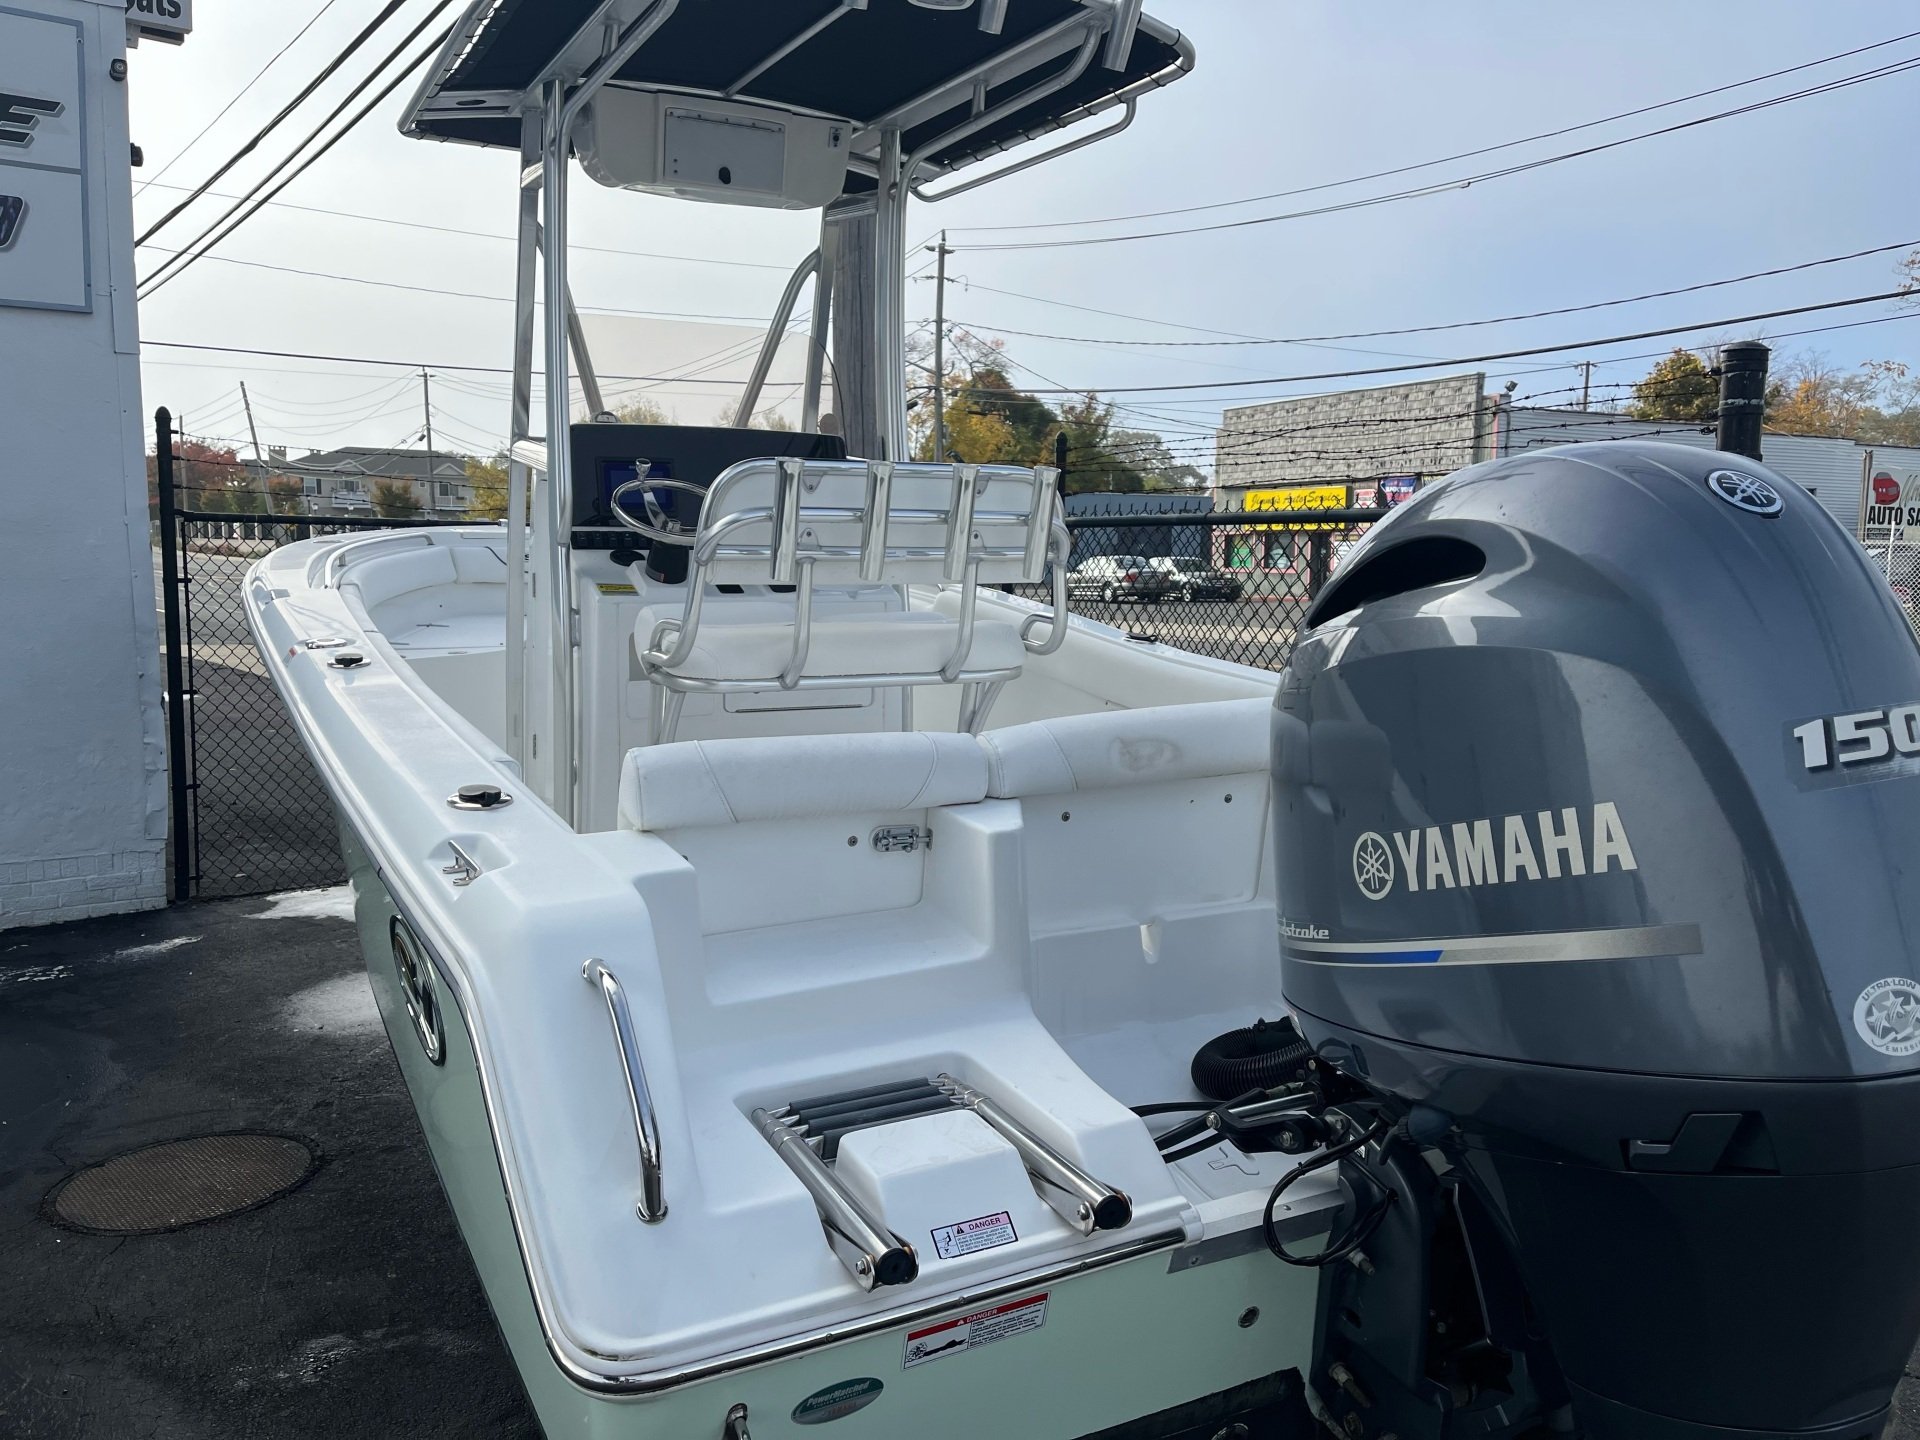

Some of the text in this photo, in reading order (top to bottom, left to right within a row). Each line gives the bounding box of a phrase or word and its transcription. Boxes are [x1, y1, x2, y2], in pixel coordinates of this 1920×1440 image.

[1867, 505, 1903, 526] AUTO
[1793, 704, 1920, 769] 150
[1393, 802, 1638, 891] YAMAHA
[1885, 1041, 1920, 1053] EMISSI
[968, 1217, 1001, 1231] DANGER
[966, 1309, 998, 1323] DANGER
